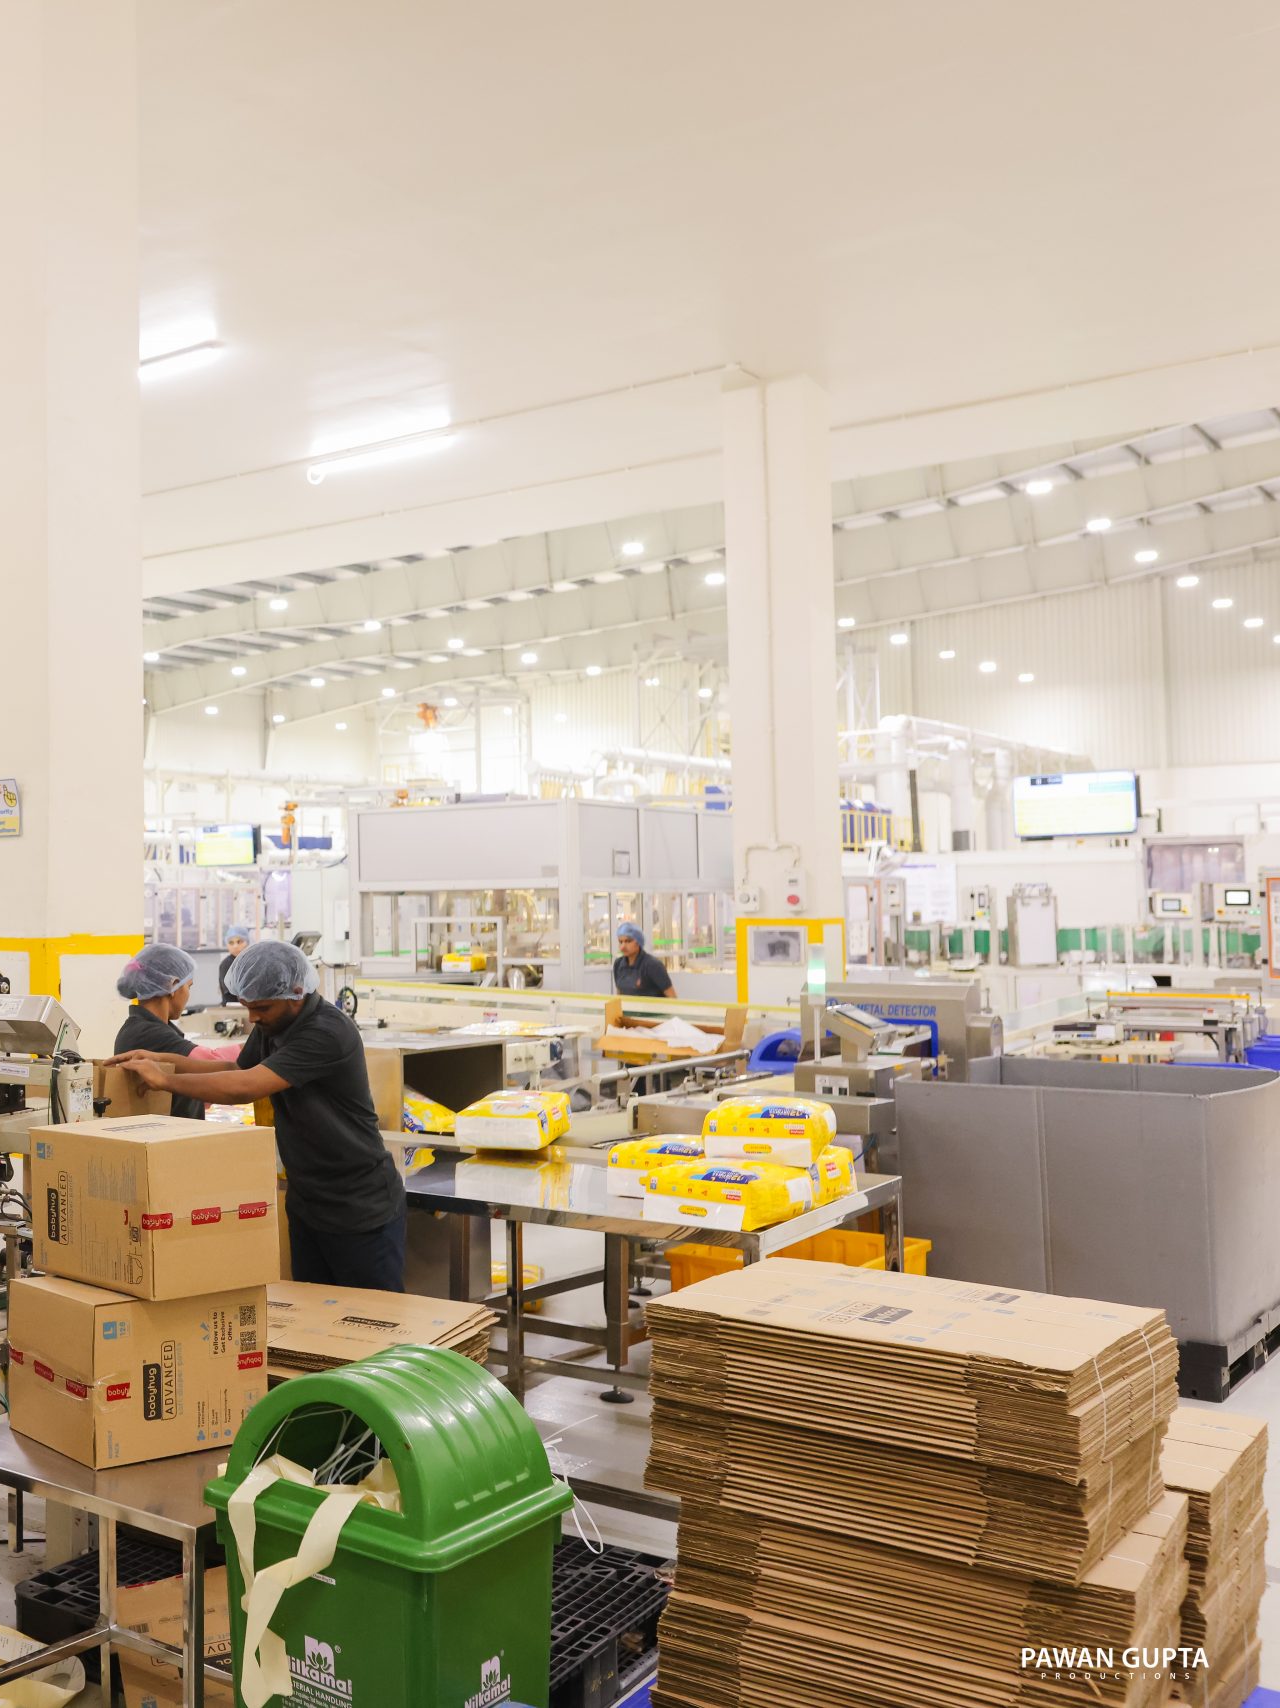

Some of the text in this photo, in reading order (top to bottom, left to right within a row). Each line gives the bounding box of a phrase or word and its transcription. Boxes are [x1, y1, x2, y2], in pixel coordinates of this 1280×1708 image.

[888, 1004, 937, 1017] DETECTOR
[60, 1174, 68, 1241] ADVANCED
[213, 1311, 218, 1319] to
[213, 1320, 219, 1329] us
[148, 1367, 157, 1418] babyhug
[163, 1344, 173, 1415] ADVANCED
[287, 1654, 353, 1695] ilkamal
[464, 1673, 511, 1708] Nilkamal
[293, 1680, 314, 1696] TERIAL
[315, 1690, 353, 1708] HANDLING
